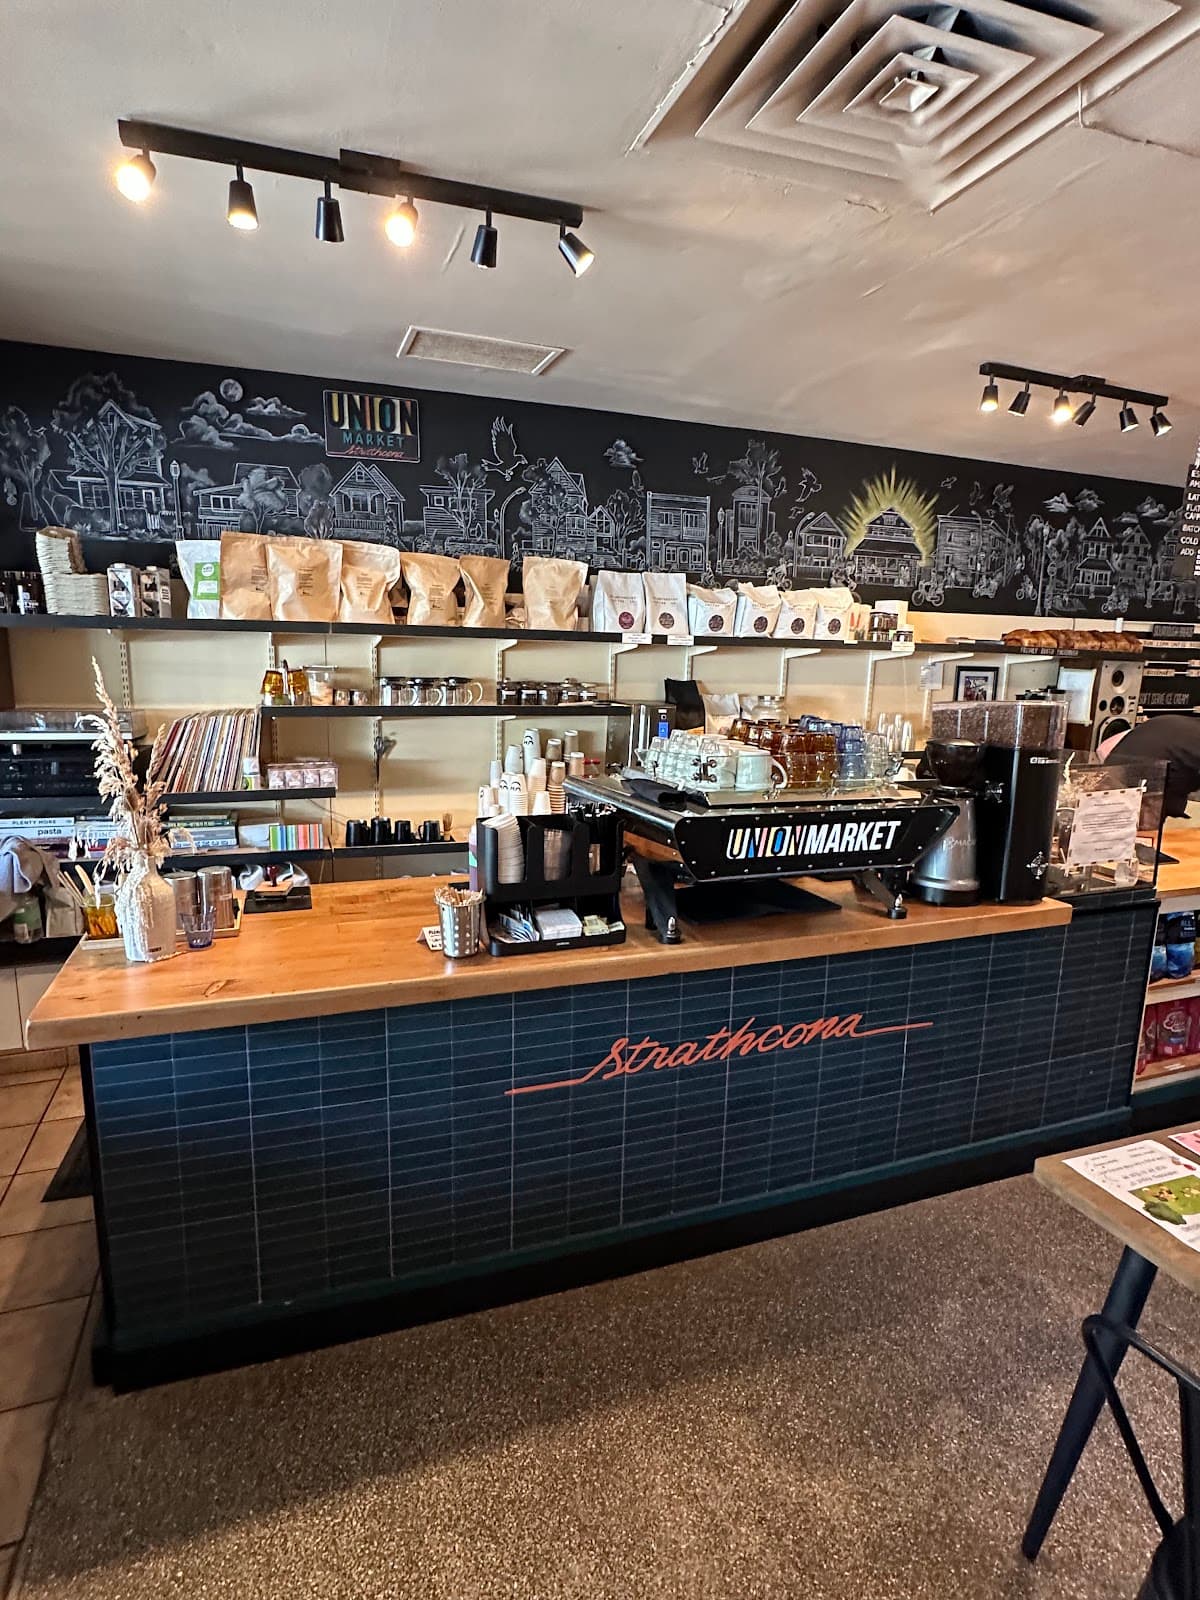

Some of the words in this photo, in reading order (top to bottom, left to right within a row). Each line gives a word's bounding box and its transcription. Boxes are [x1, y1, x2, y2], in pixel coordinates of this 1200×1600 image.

[327, 391, 415, 436] UNION
[342, 431, 405, 448] MARKET
[1180, 536, 1199, 545] COLD
[37, 828, 62, 836] pasta
[584, 1013, 872, 1081] Strathcona
